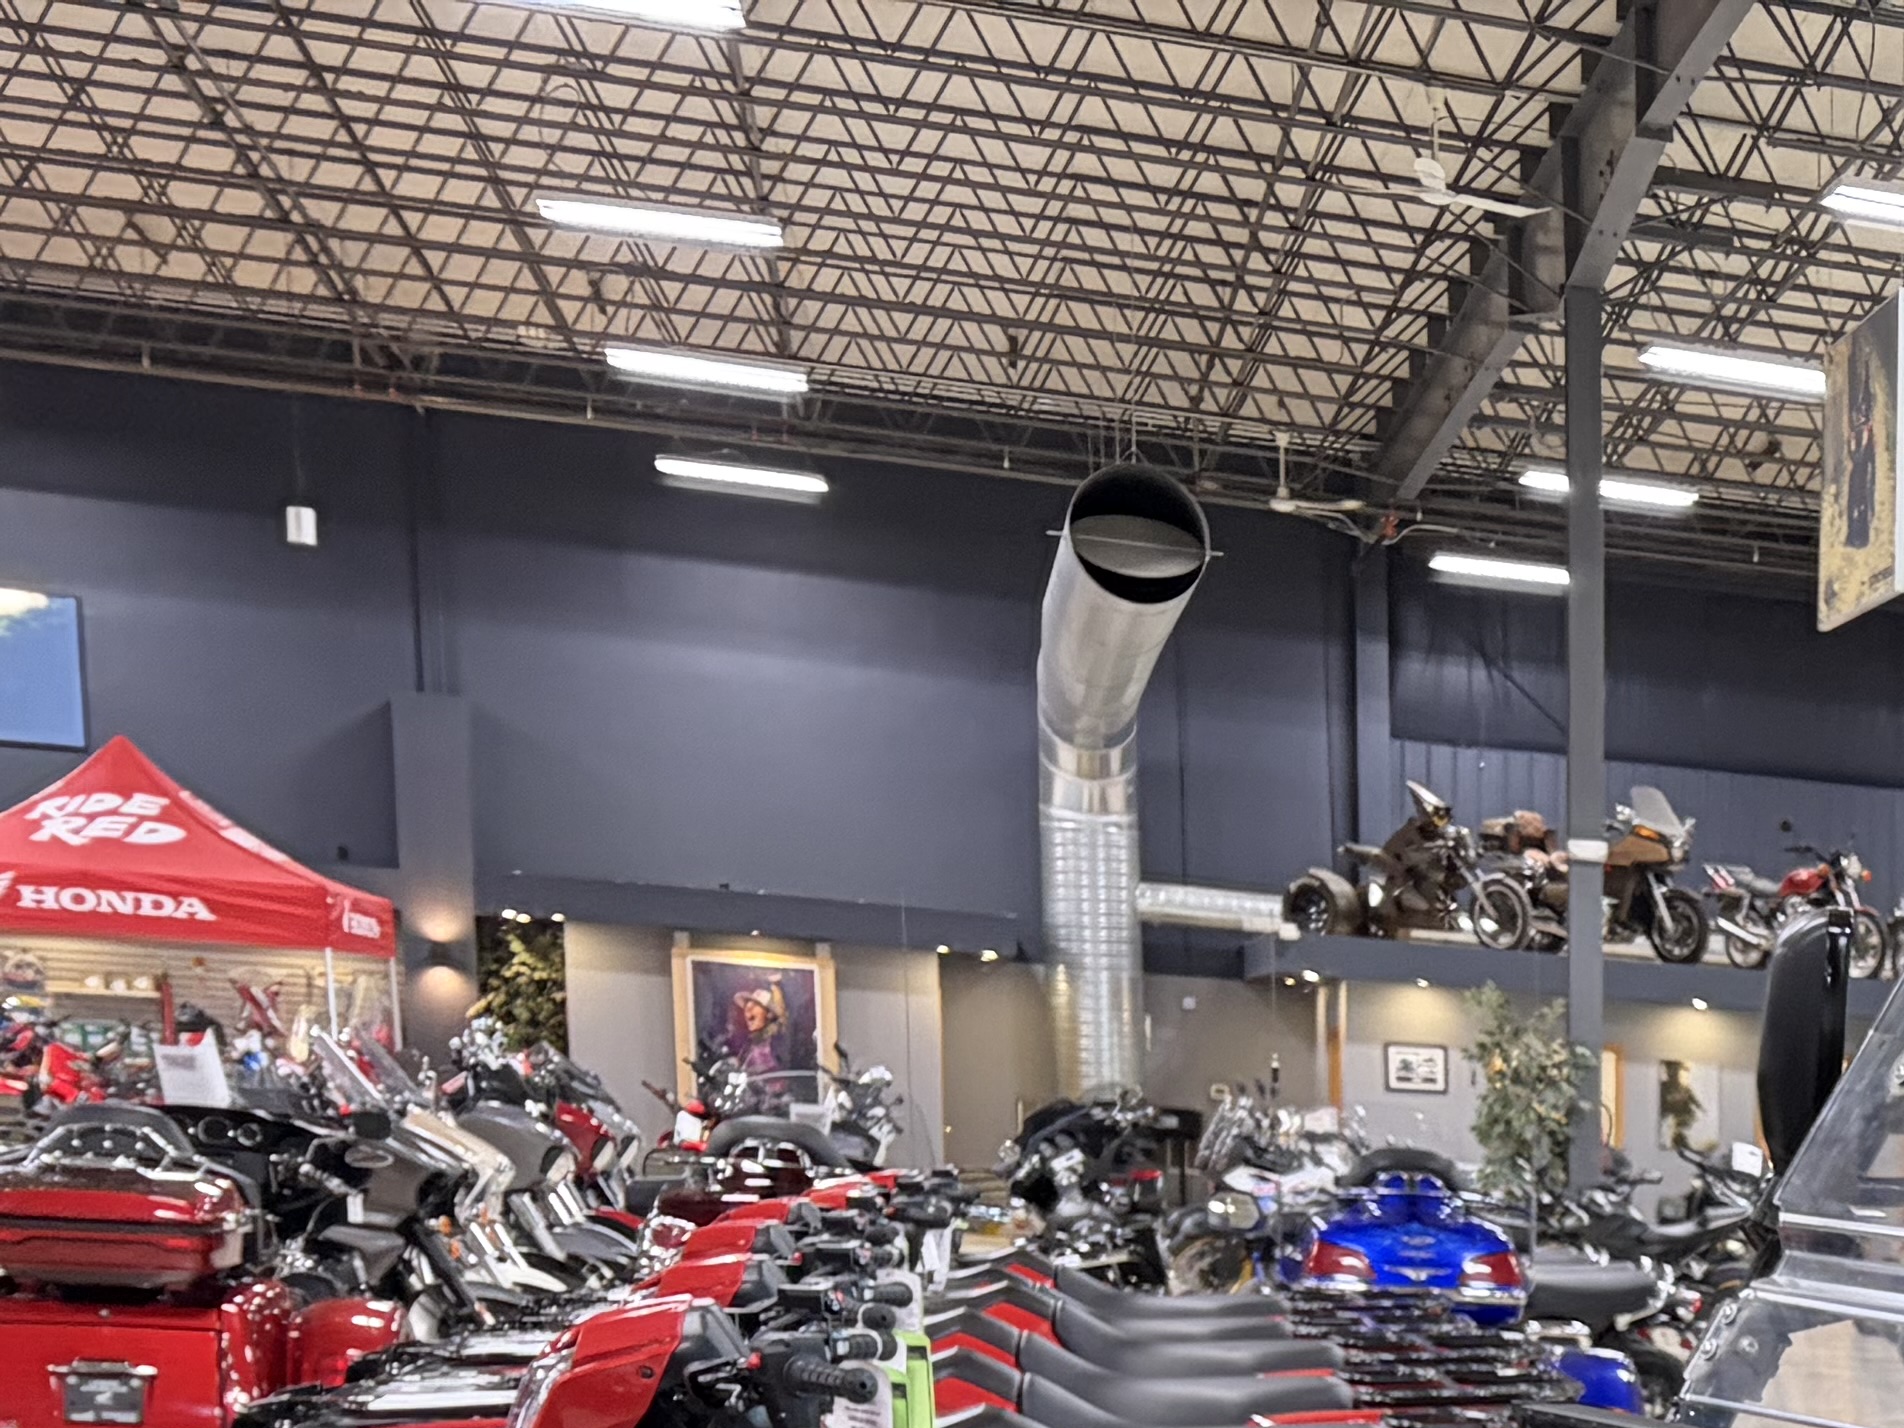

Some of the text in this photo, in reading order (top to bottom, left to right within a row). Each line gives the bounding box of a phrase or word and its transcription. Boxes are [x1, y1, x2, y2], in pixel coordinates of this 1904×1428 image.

[25, 792, 171, 820] RIDE
[29, 815, 187, 846] RED
[15, 885, 218, 922] HONDA
